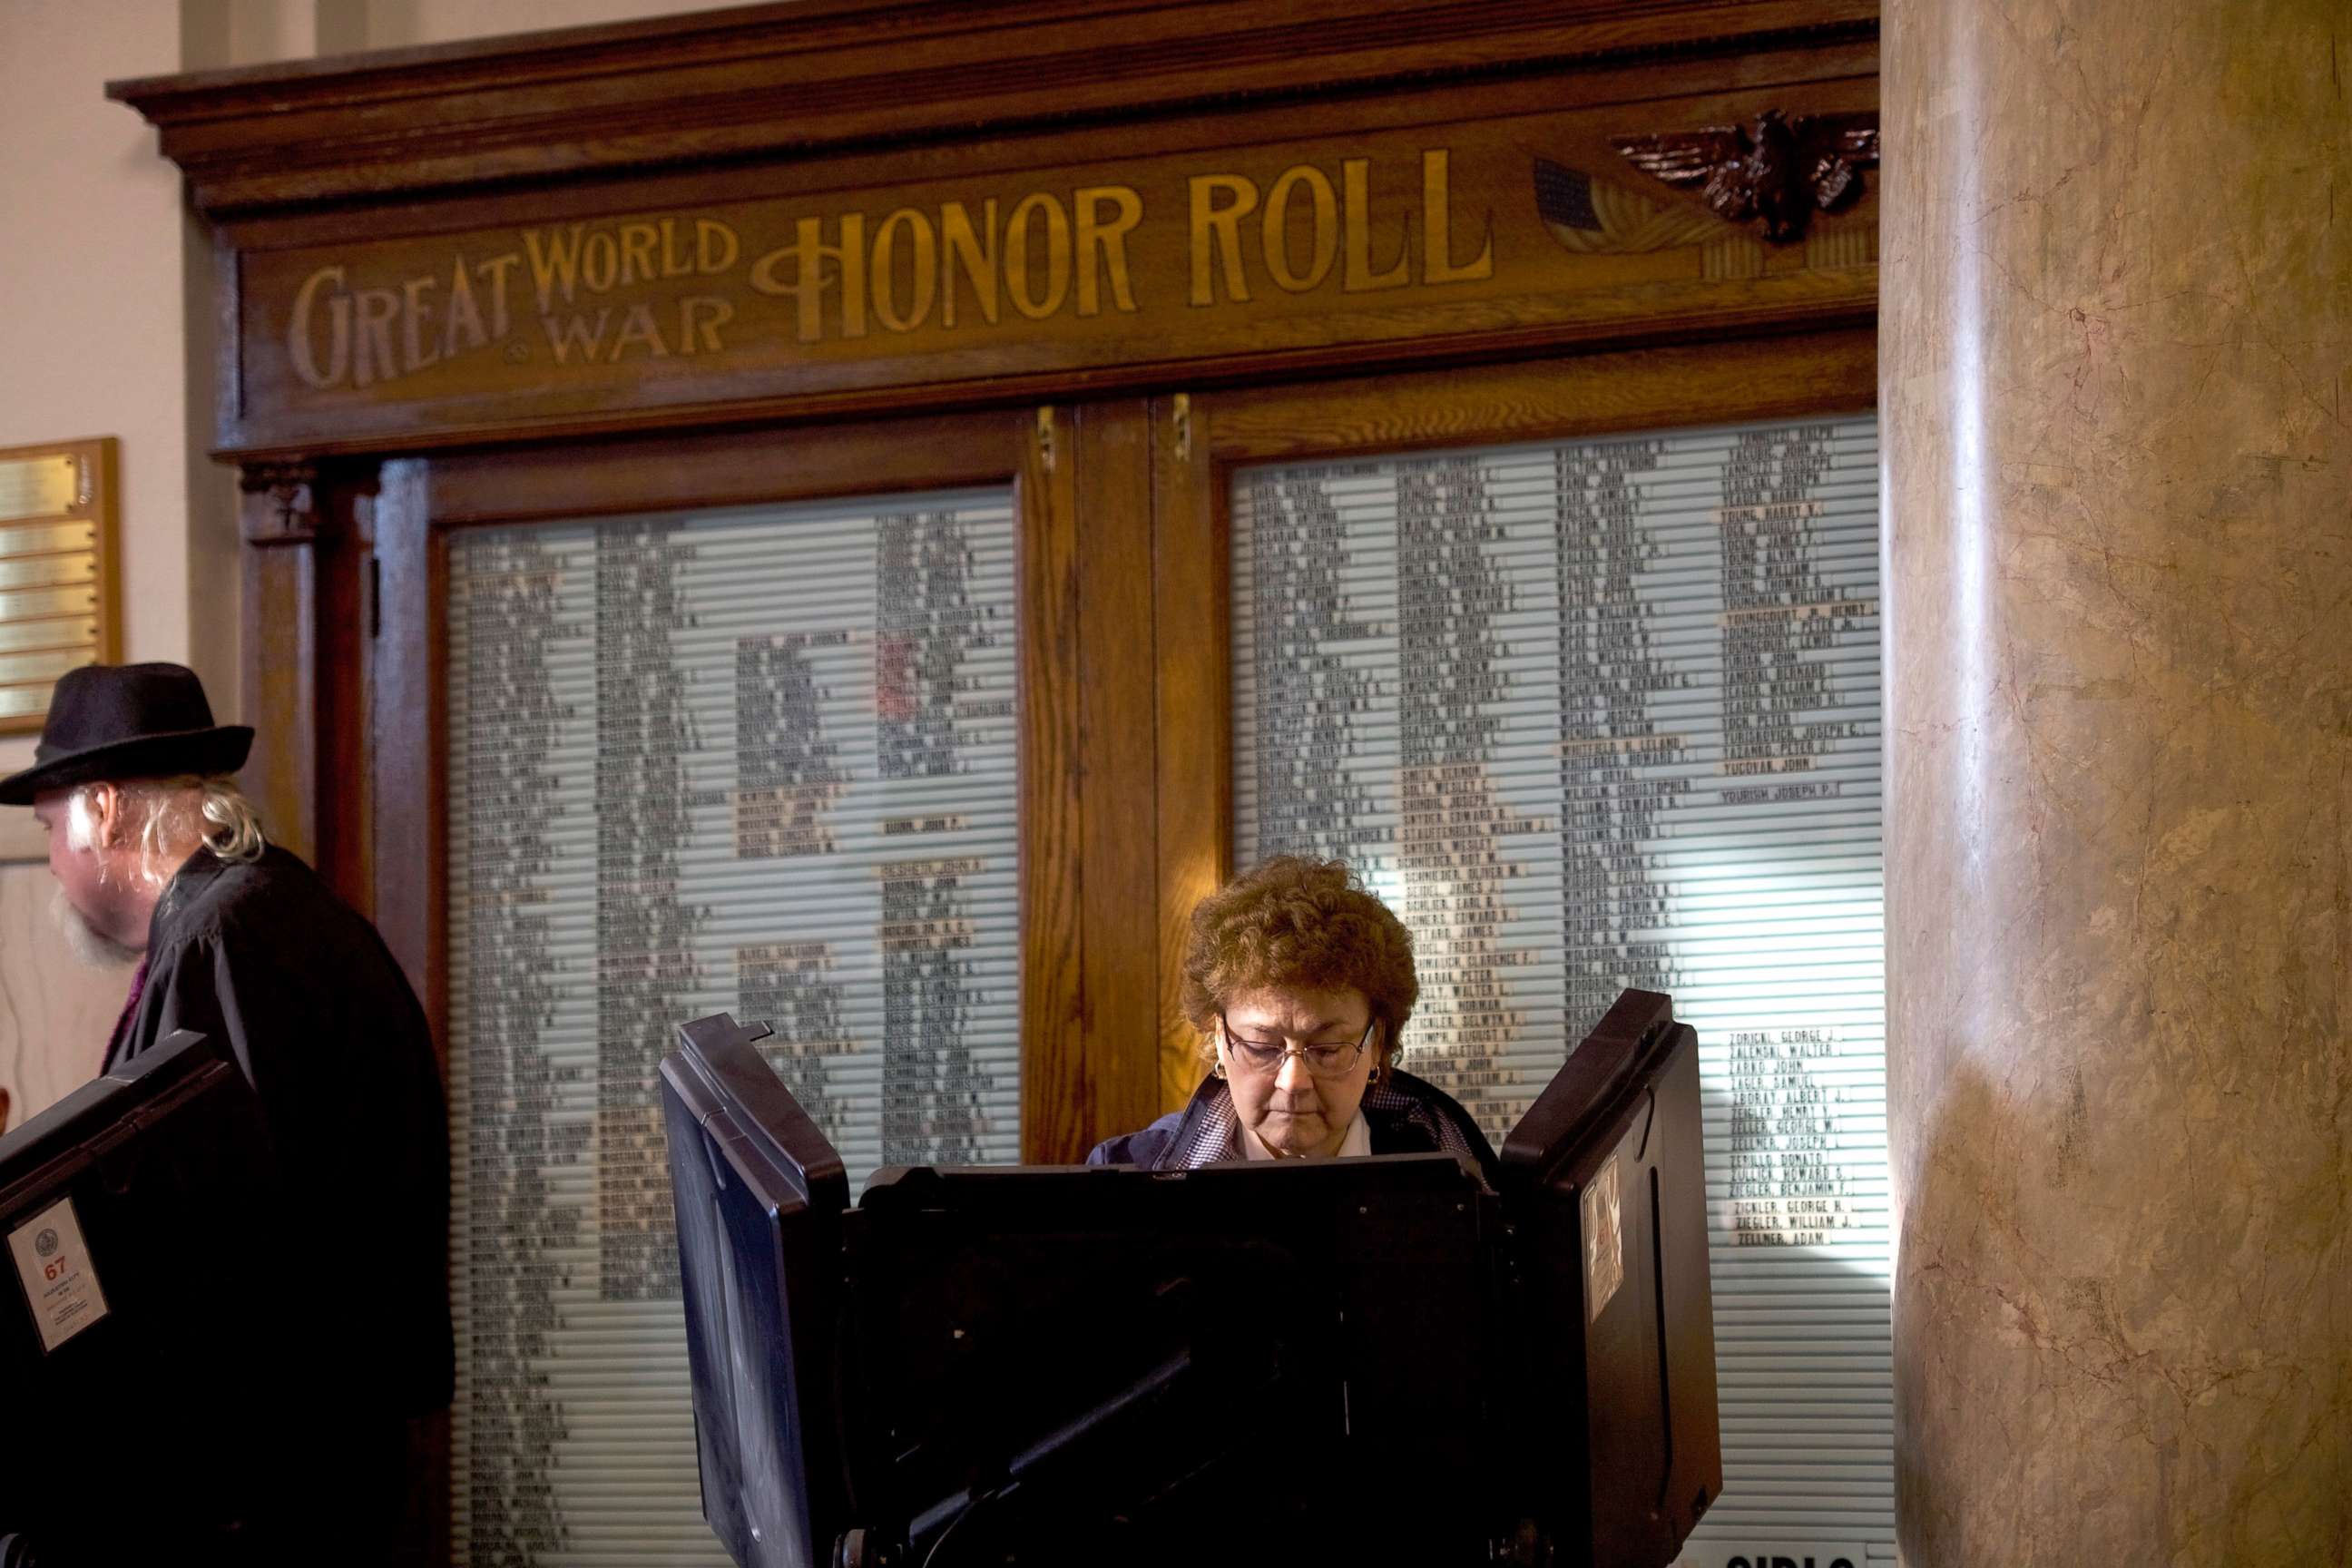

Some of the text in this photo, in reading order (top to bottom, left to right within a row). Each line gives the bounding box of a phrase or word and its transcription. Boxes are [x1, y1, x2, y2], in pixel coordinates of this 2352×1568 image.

[287, 149, 1494, 390] GREAT WORLD HONOR ROLL
[544, 297, 735, 364] WAR
[1802, 722, 1845, 740] JOSEPH
[1780, 740, 1814, 755] PETER
[1783, 758, 1810, 772] JOHN
[1775, 783, 1816, 800] JOSEPH
[1453, 984, 1494, 999] WALTER
[1781, 1030, 1820, 1044] GEORGE
[1789, 1044, 1831, 1058] WALTER
[1773, 1060, 1803, 1074] JOHN
[1774, 1075, 1816, 1089] SAMUEL
[1786, 1089, 1826, 1104] ALBERT
[1782, 1105, 1814, 1120] HENRY
[1777, 1121, 1817, 1134] GEORGE
[1786, 1136, 1827, 1151] JOSEPH
[1783, 1167, 1829, 1182] HOWARD
[1780, 1181, 1833, 1197] BENJAMIN
[1787, 1200, 1828, 1214] GEORGE
[1788, 1215, 1835, 1229] WILLIAM
[1842, 1215, 1852, 1229] J.
[1793, 1231, 1824, 1246] ADAM
[44, 1256, 65, 1280] 67
